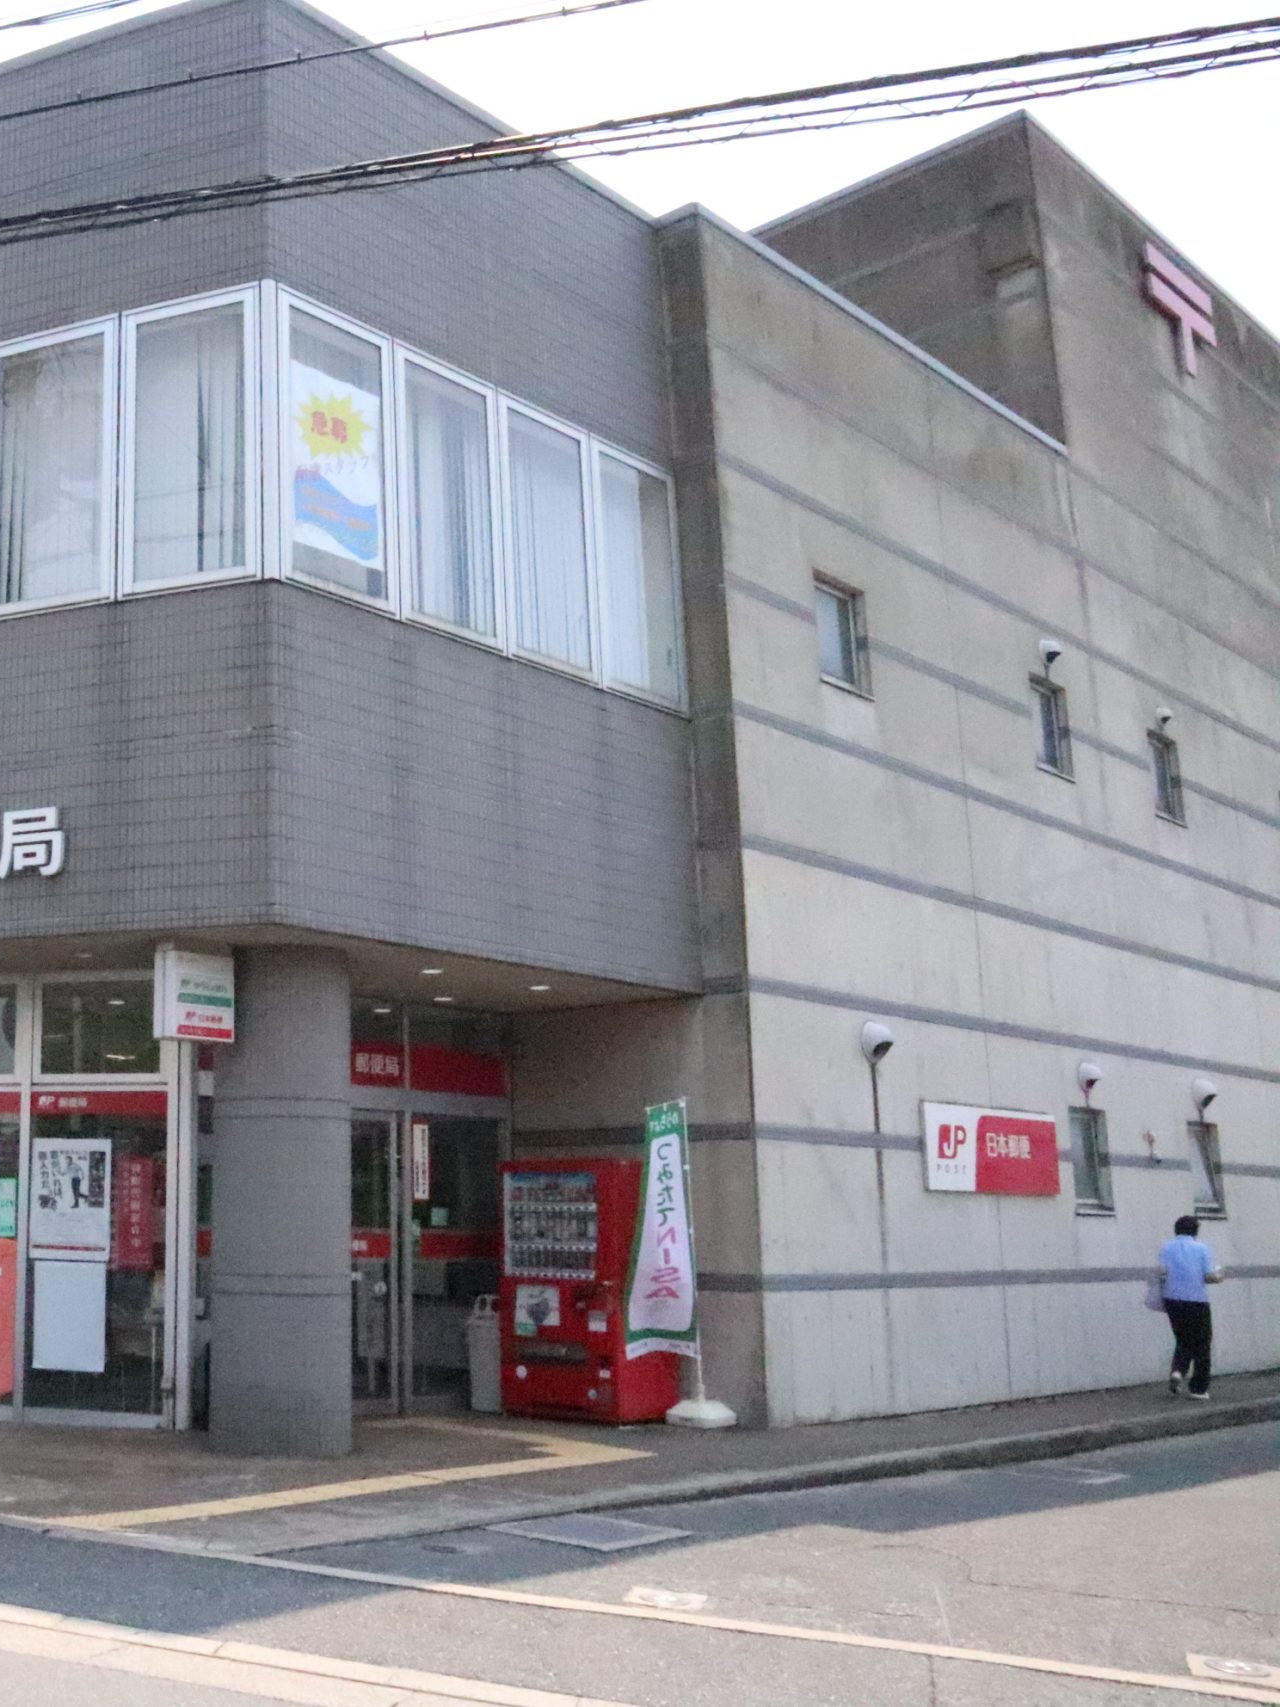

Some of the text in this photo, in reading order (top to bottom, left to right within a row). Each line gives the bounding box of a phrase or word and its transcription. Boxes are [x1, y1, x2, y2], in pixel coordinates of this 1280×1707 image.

[355, 1052, 400, 1076] 郵便局
[937, 1124, 1032, 1160] JP 日本郵便
[936, 1163, 967, 1174] POST
